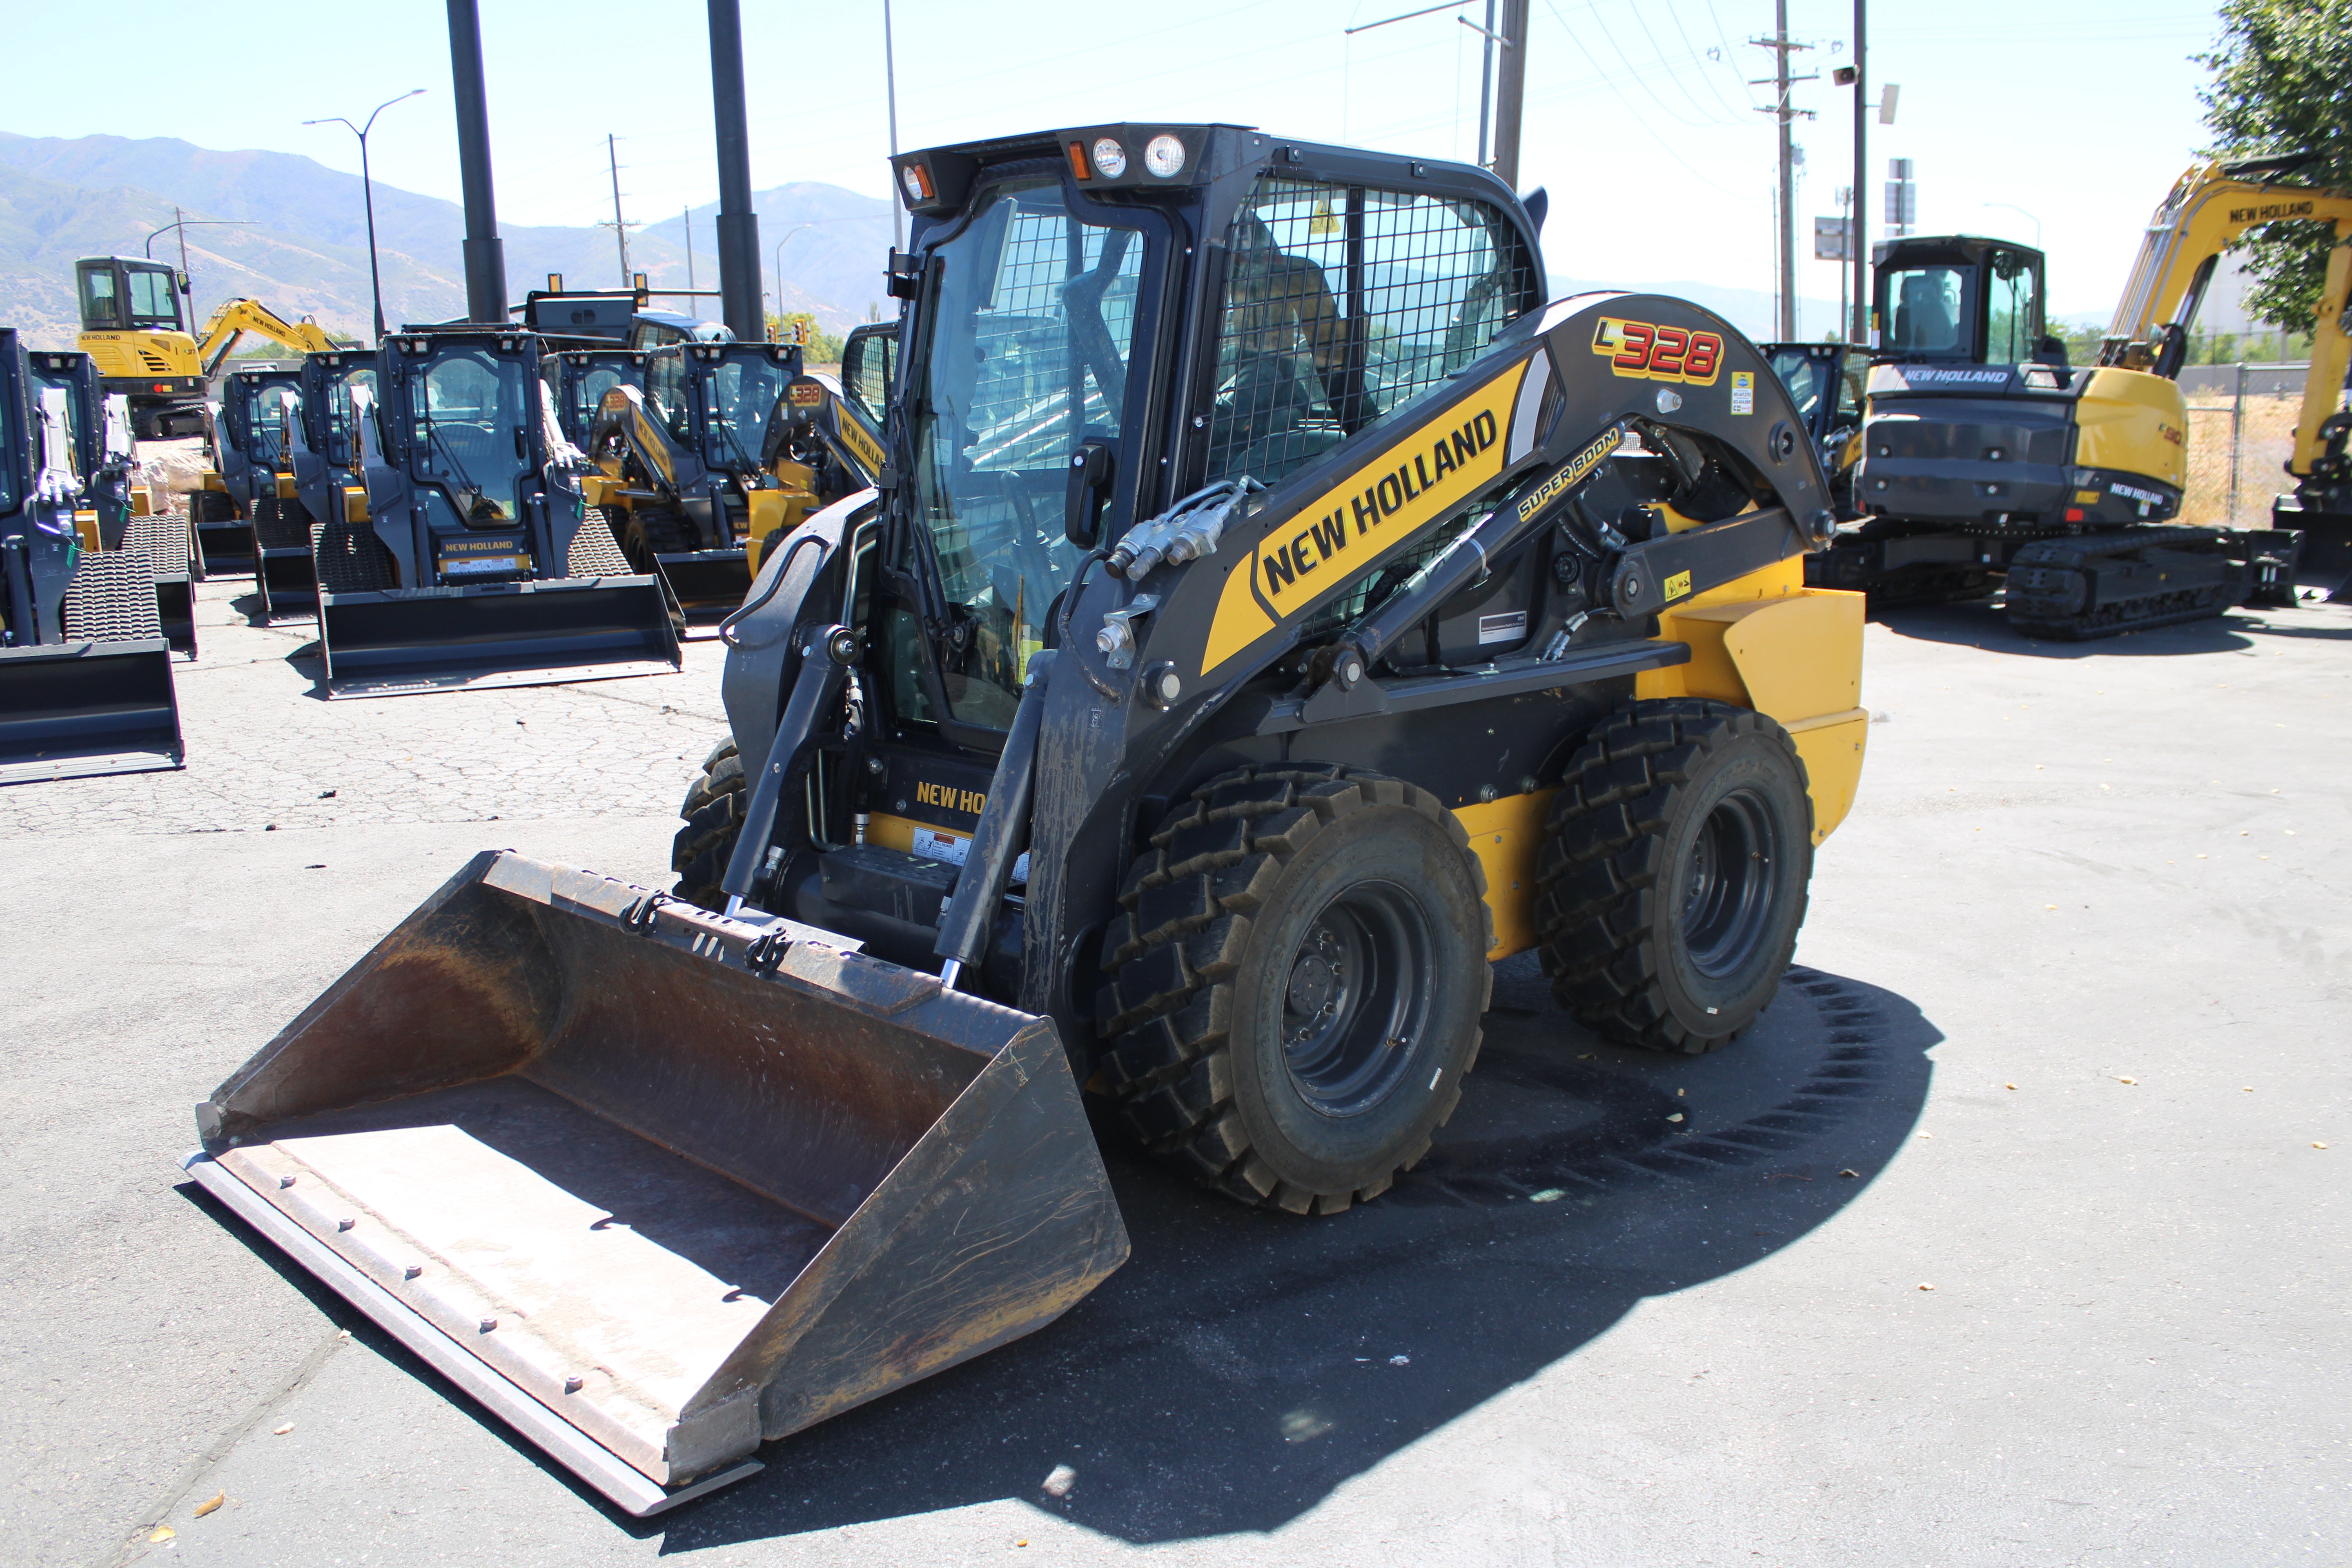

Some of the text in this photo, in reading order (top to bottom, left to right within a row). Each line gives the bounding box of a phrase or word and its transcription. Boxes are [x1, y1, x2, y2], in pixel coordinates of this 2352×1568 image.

[2230, 201, 2314, 223] NEW HOLLAND
[253, 316, 287, 337] NEW HOLLAND
[1903, 369, 2009, 383] NEW HOLLAND
[842, 416, 858, 443] NEW
[858, 434, 882, 468] HOLLA
[1263, 408, 1498, 597] NEW HOLLAND
[2110, 482, 2163, 506] NEW HOLLAND
[445, 541, 513, 552] NEW HOLLAND
[917, 781, 957, 808] NEW
